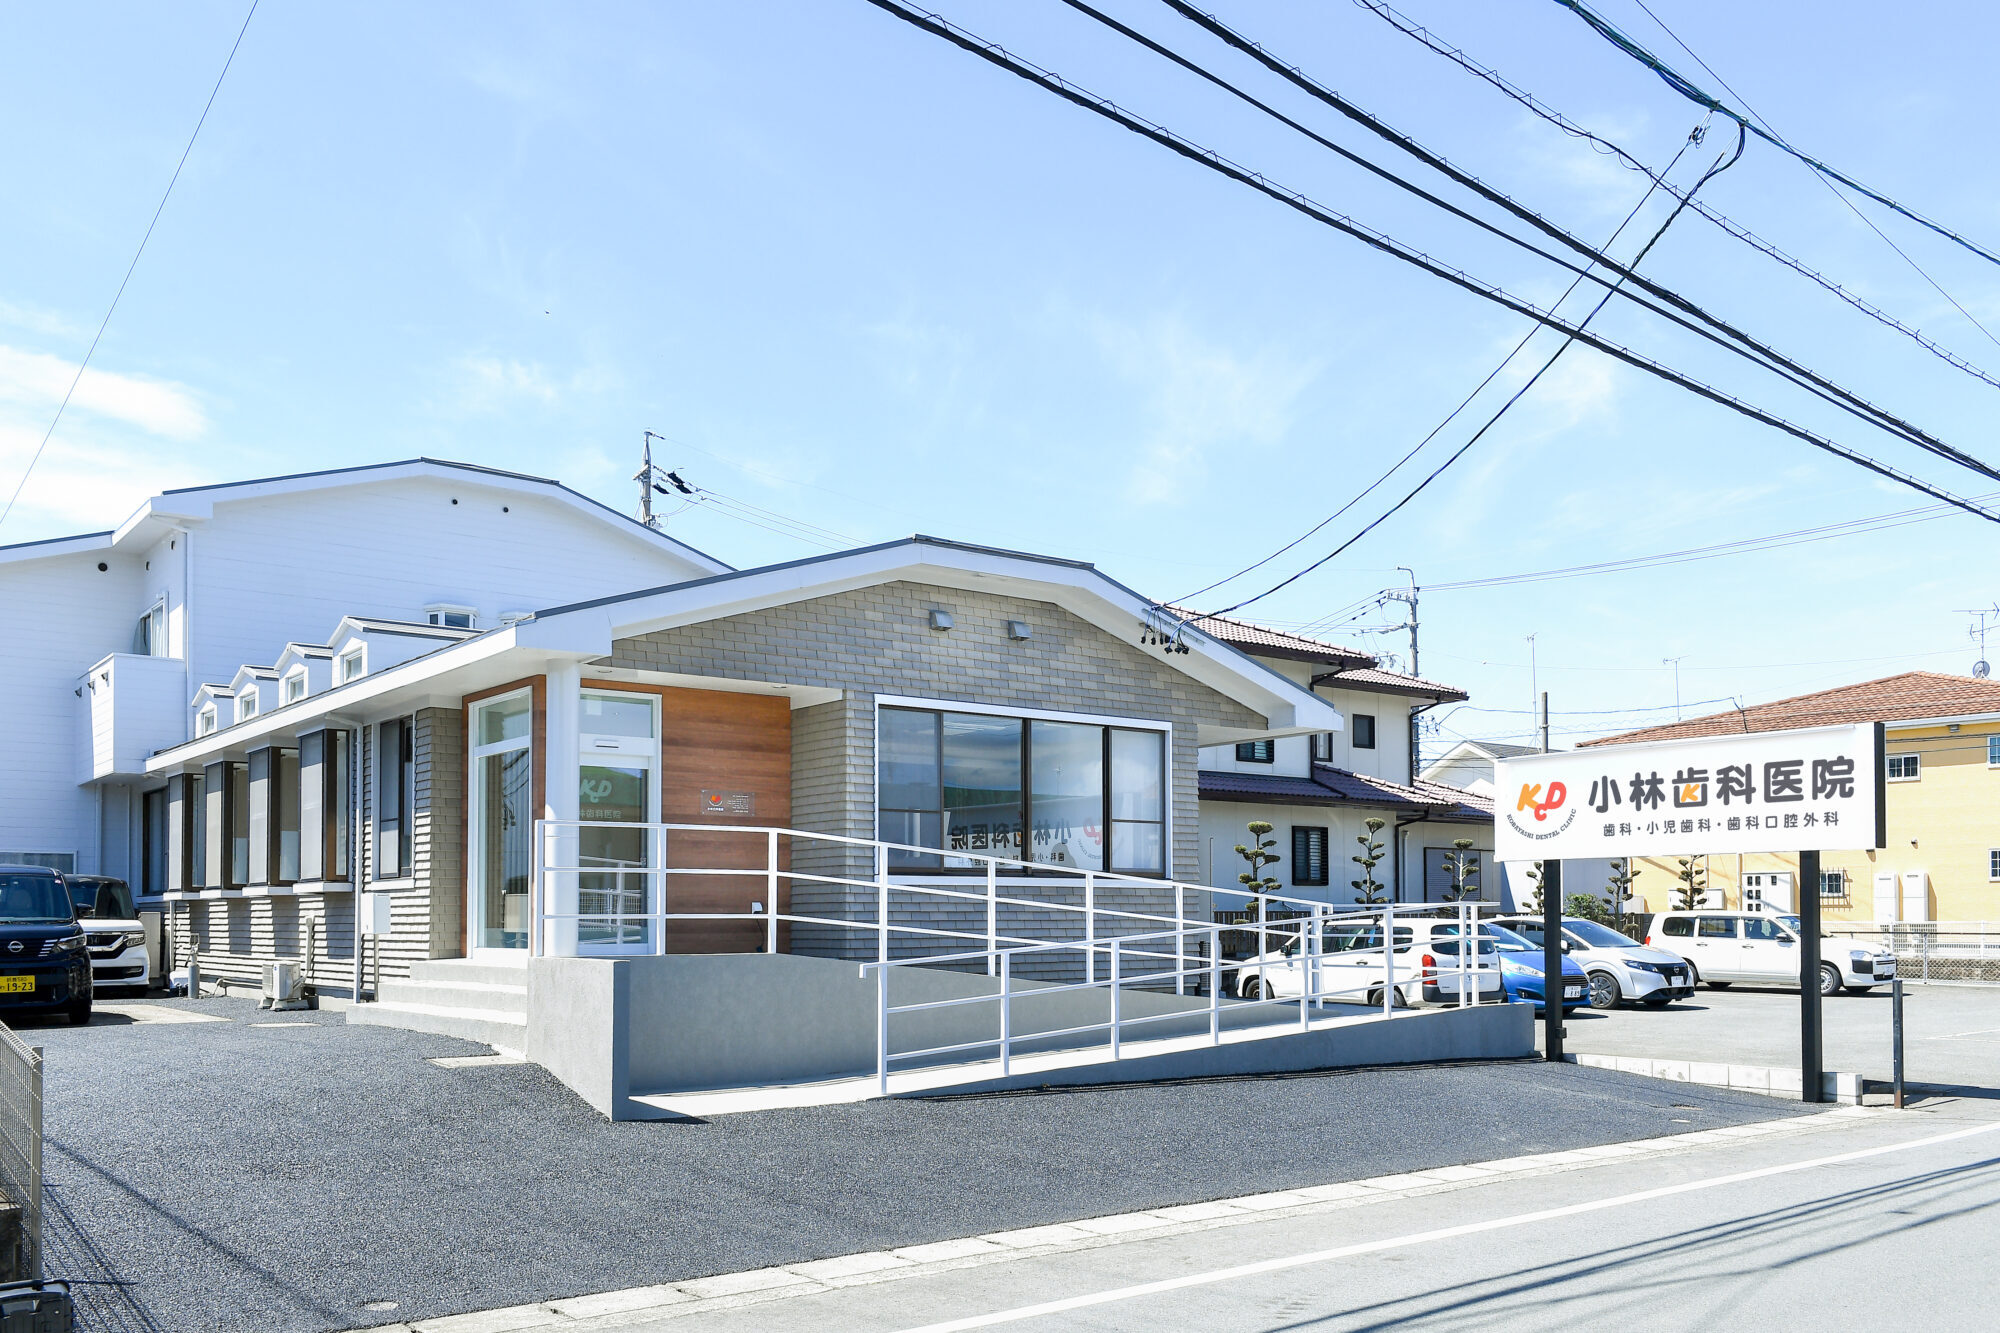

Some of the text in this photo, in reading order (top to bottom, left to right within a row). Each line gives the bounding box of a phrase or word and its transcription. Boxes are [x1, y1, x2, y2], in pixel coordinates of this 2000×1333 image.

[1588, 756, 1855, 813] 小林歯科医院
[1507, 808, 1577, 840] KOBAYASHI DENTAL CLINIC
[7, 982, 33, 991] 19-23
